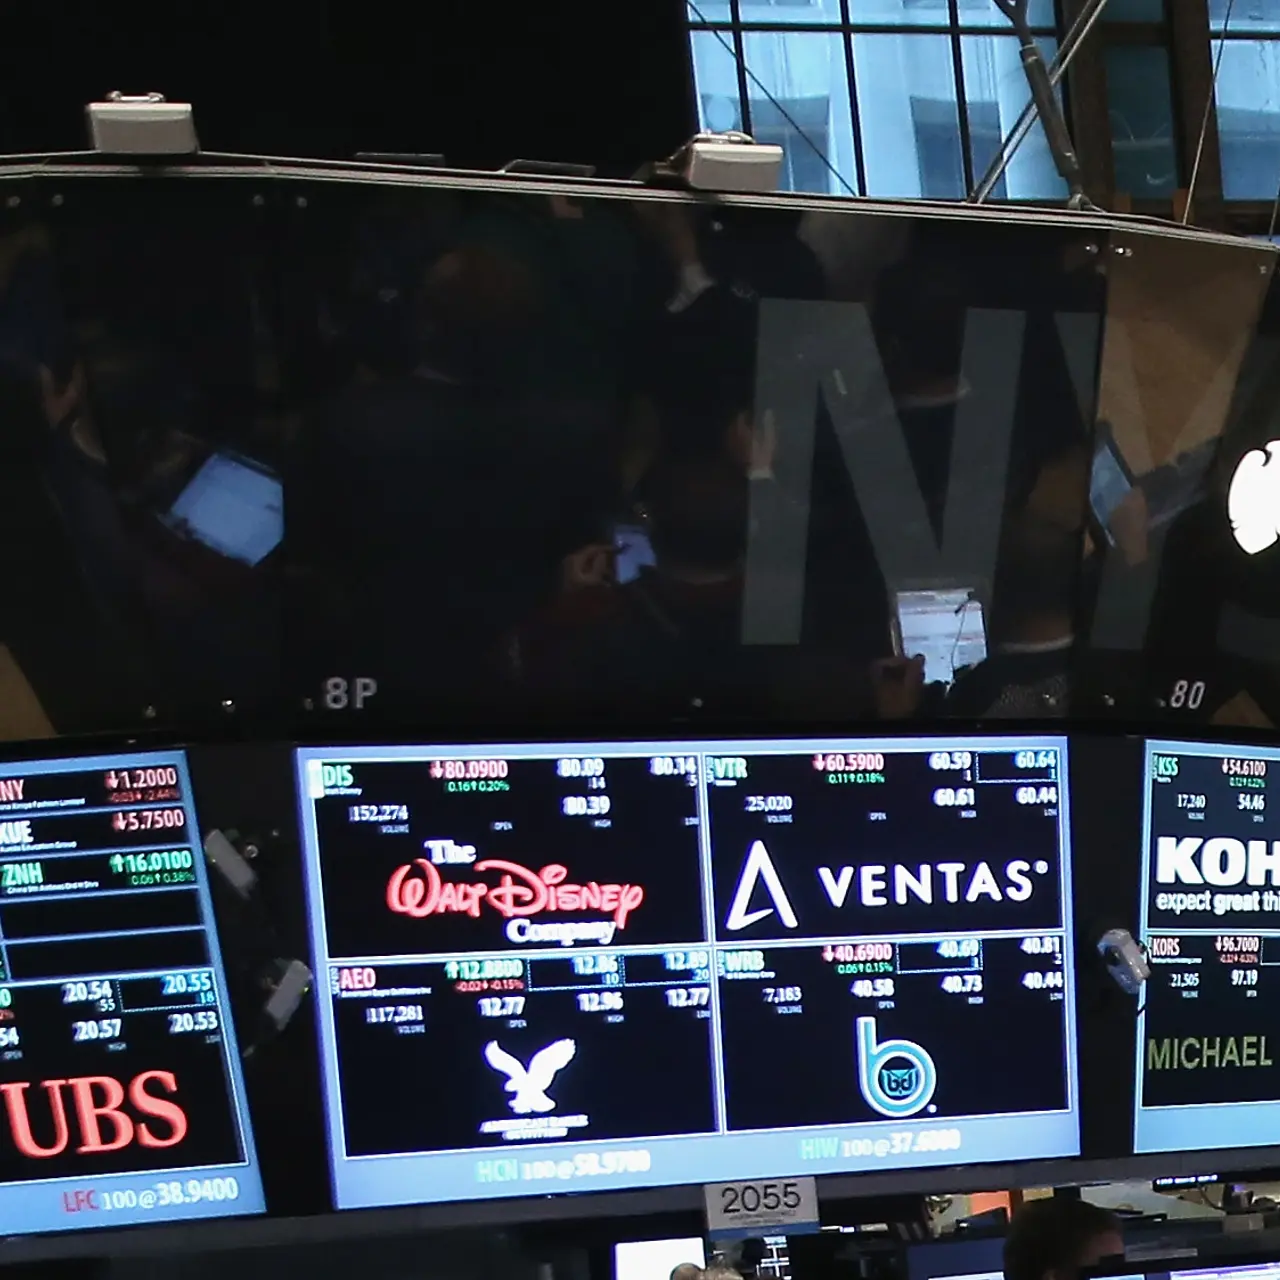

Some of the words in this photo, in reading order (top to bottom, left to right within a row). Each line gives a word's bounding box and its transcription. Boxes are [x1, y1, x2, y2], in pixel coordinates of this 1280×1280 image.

[325, 677, 377, 710] 8P
[324, 765, 353, 787] DIS
[445, 761, 508, 778] 80.0900
[558, 758, 603, 776] 80.09
[650, 757, 696, 775] 80.14
[715, 758, 747, 778] VTR
[826, 754, 884, 772] 60.5900
[930, 752, 971, 770] 60.59
[1015, 751, 1056, 768] 60.64
[1159, 758, 1178, 776] KSS
[1229, 760, 1266, 776] 54.6100
[122, 768, 176, 789] 1.2000
[1238, 794, 1264, 810] 54.46
[127, 810, 184, 831] 5.7500
[425, 840, 476, 864] The
[2, 863, 43, 885] ZNH
[127, 851, 192, 871] 16.0100
[1156, 890, 1211, 914] expect
[1213, 891, 1260, 915] great
[1153, 938, 1179, 956] KORS
[64, 981, 112, 1002] 20.54
[167, 973, 211, 993] 20.55
[340, 968, 376, 989] AEO
[1232, 970, 1258, 985] 97.19
[100, 1000, 115, 1012] 55
[478, 996, 525, 1016] 12.77
[666, 988, 709, 1007] 12.77
[75, 1019, 122, 1041] 20.57
[171, 1012, 217, 1033] 20.53
[1148, 1035, 1272, 1070] MICHAEL
[0, 1070, 187, 1158] UBS
[63, 1190, 99, 1212] LFC
[722, 1183, 801, 1213] 2055
